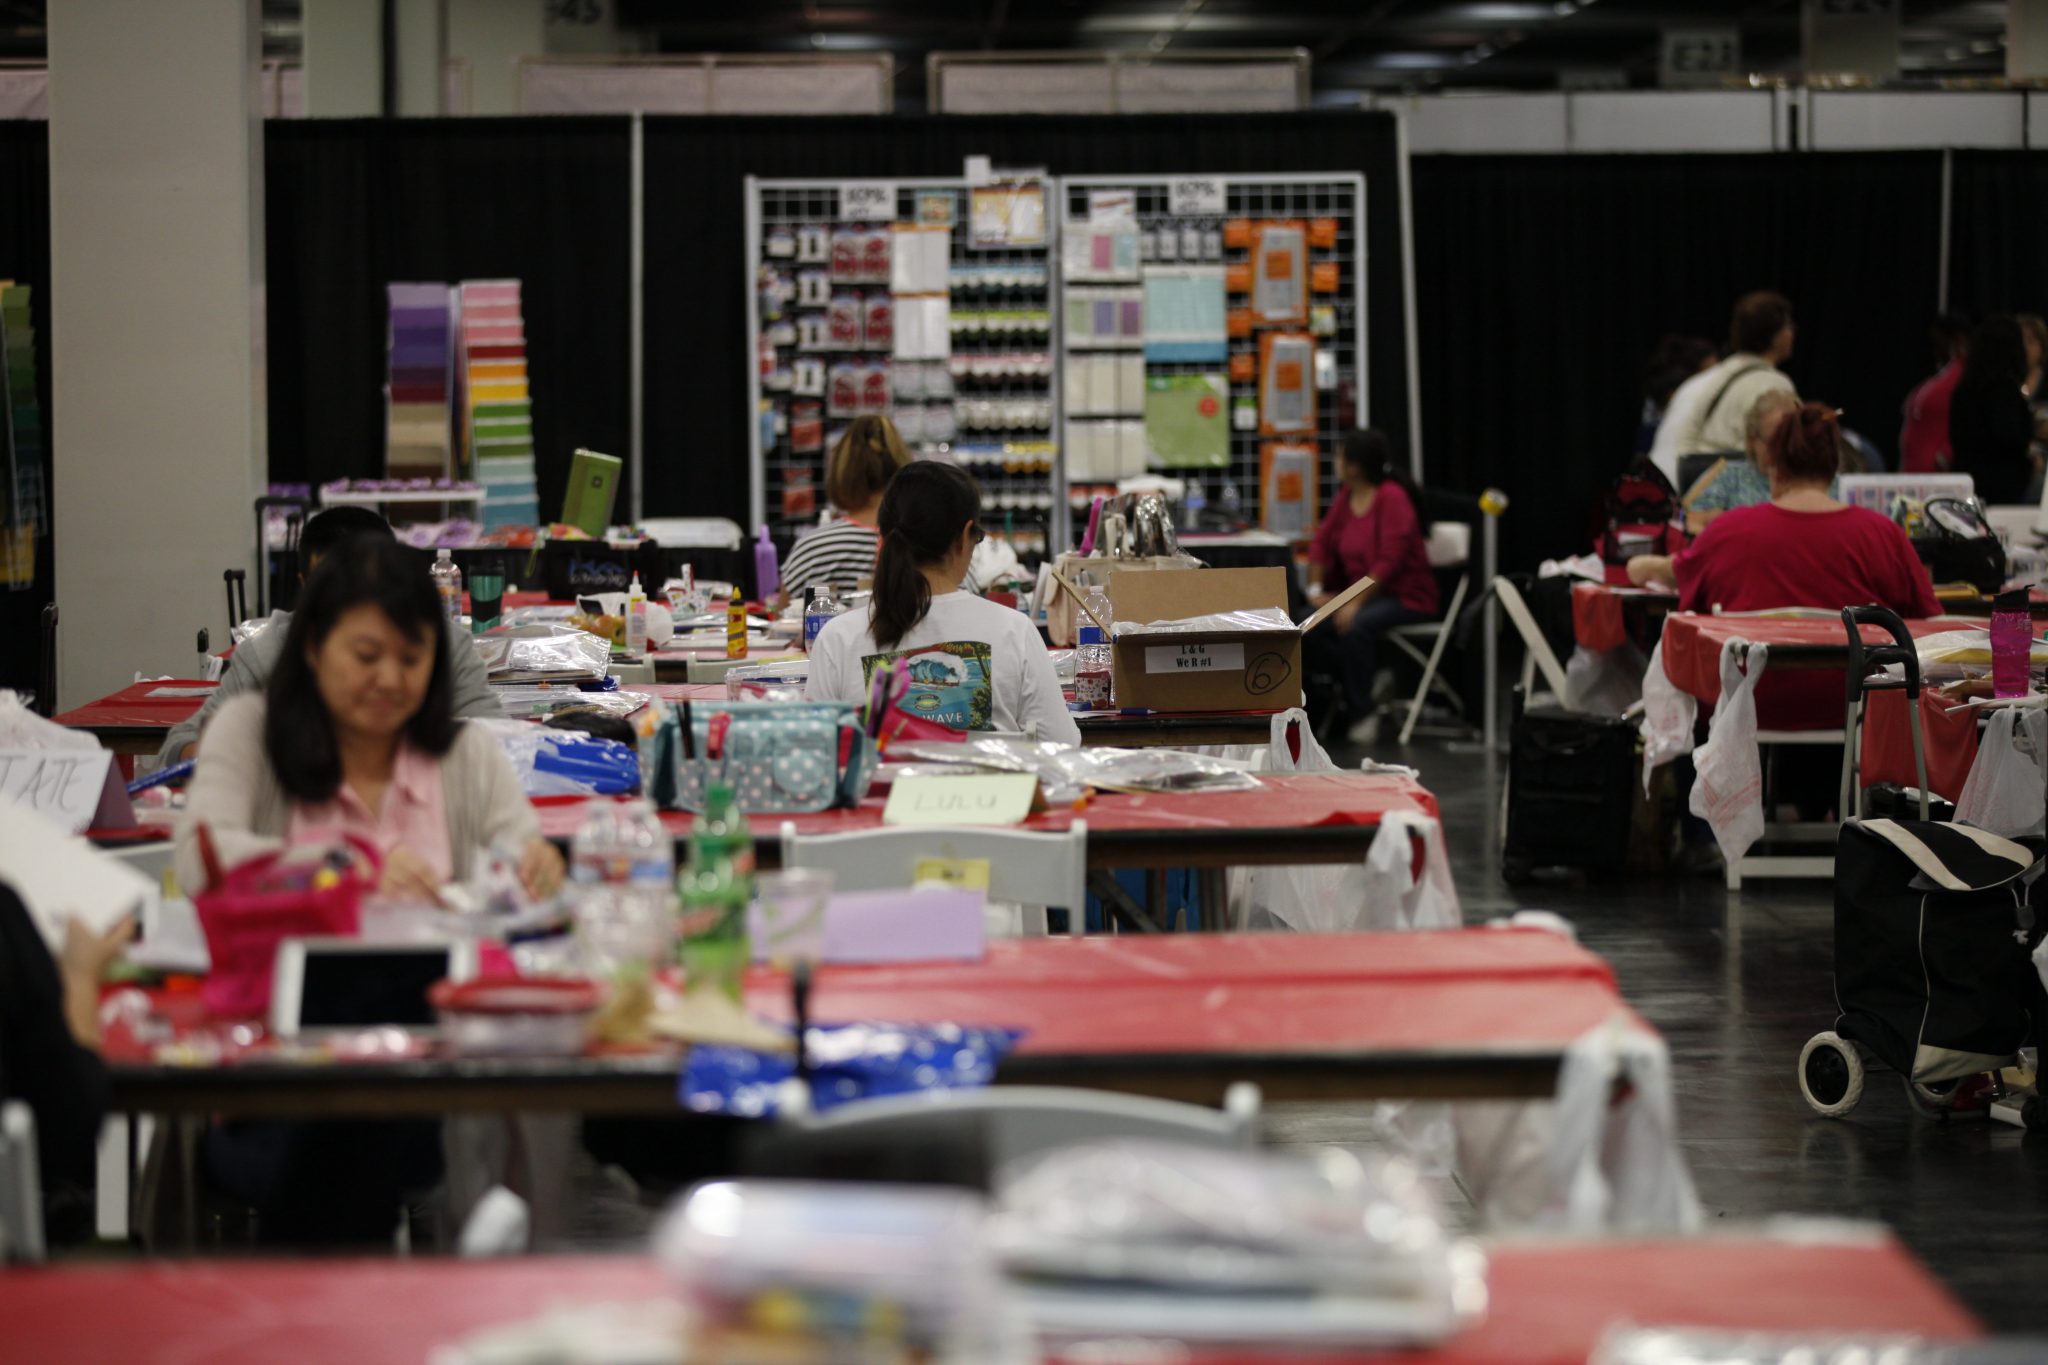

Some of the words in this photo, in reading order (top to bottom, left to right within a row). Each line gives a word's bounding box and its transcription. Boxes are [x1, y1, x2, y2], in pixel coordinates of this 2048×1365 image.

[1176, 657, 1189, 667] We
[1192, 657, 1198, 667] R
[913, 793, 998, 812] LULU
